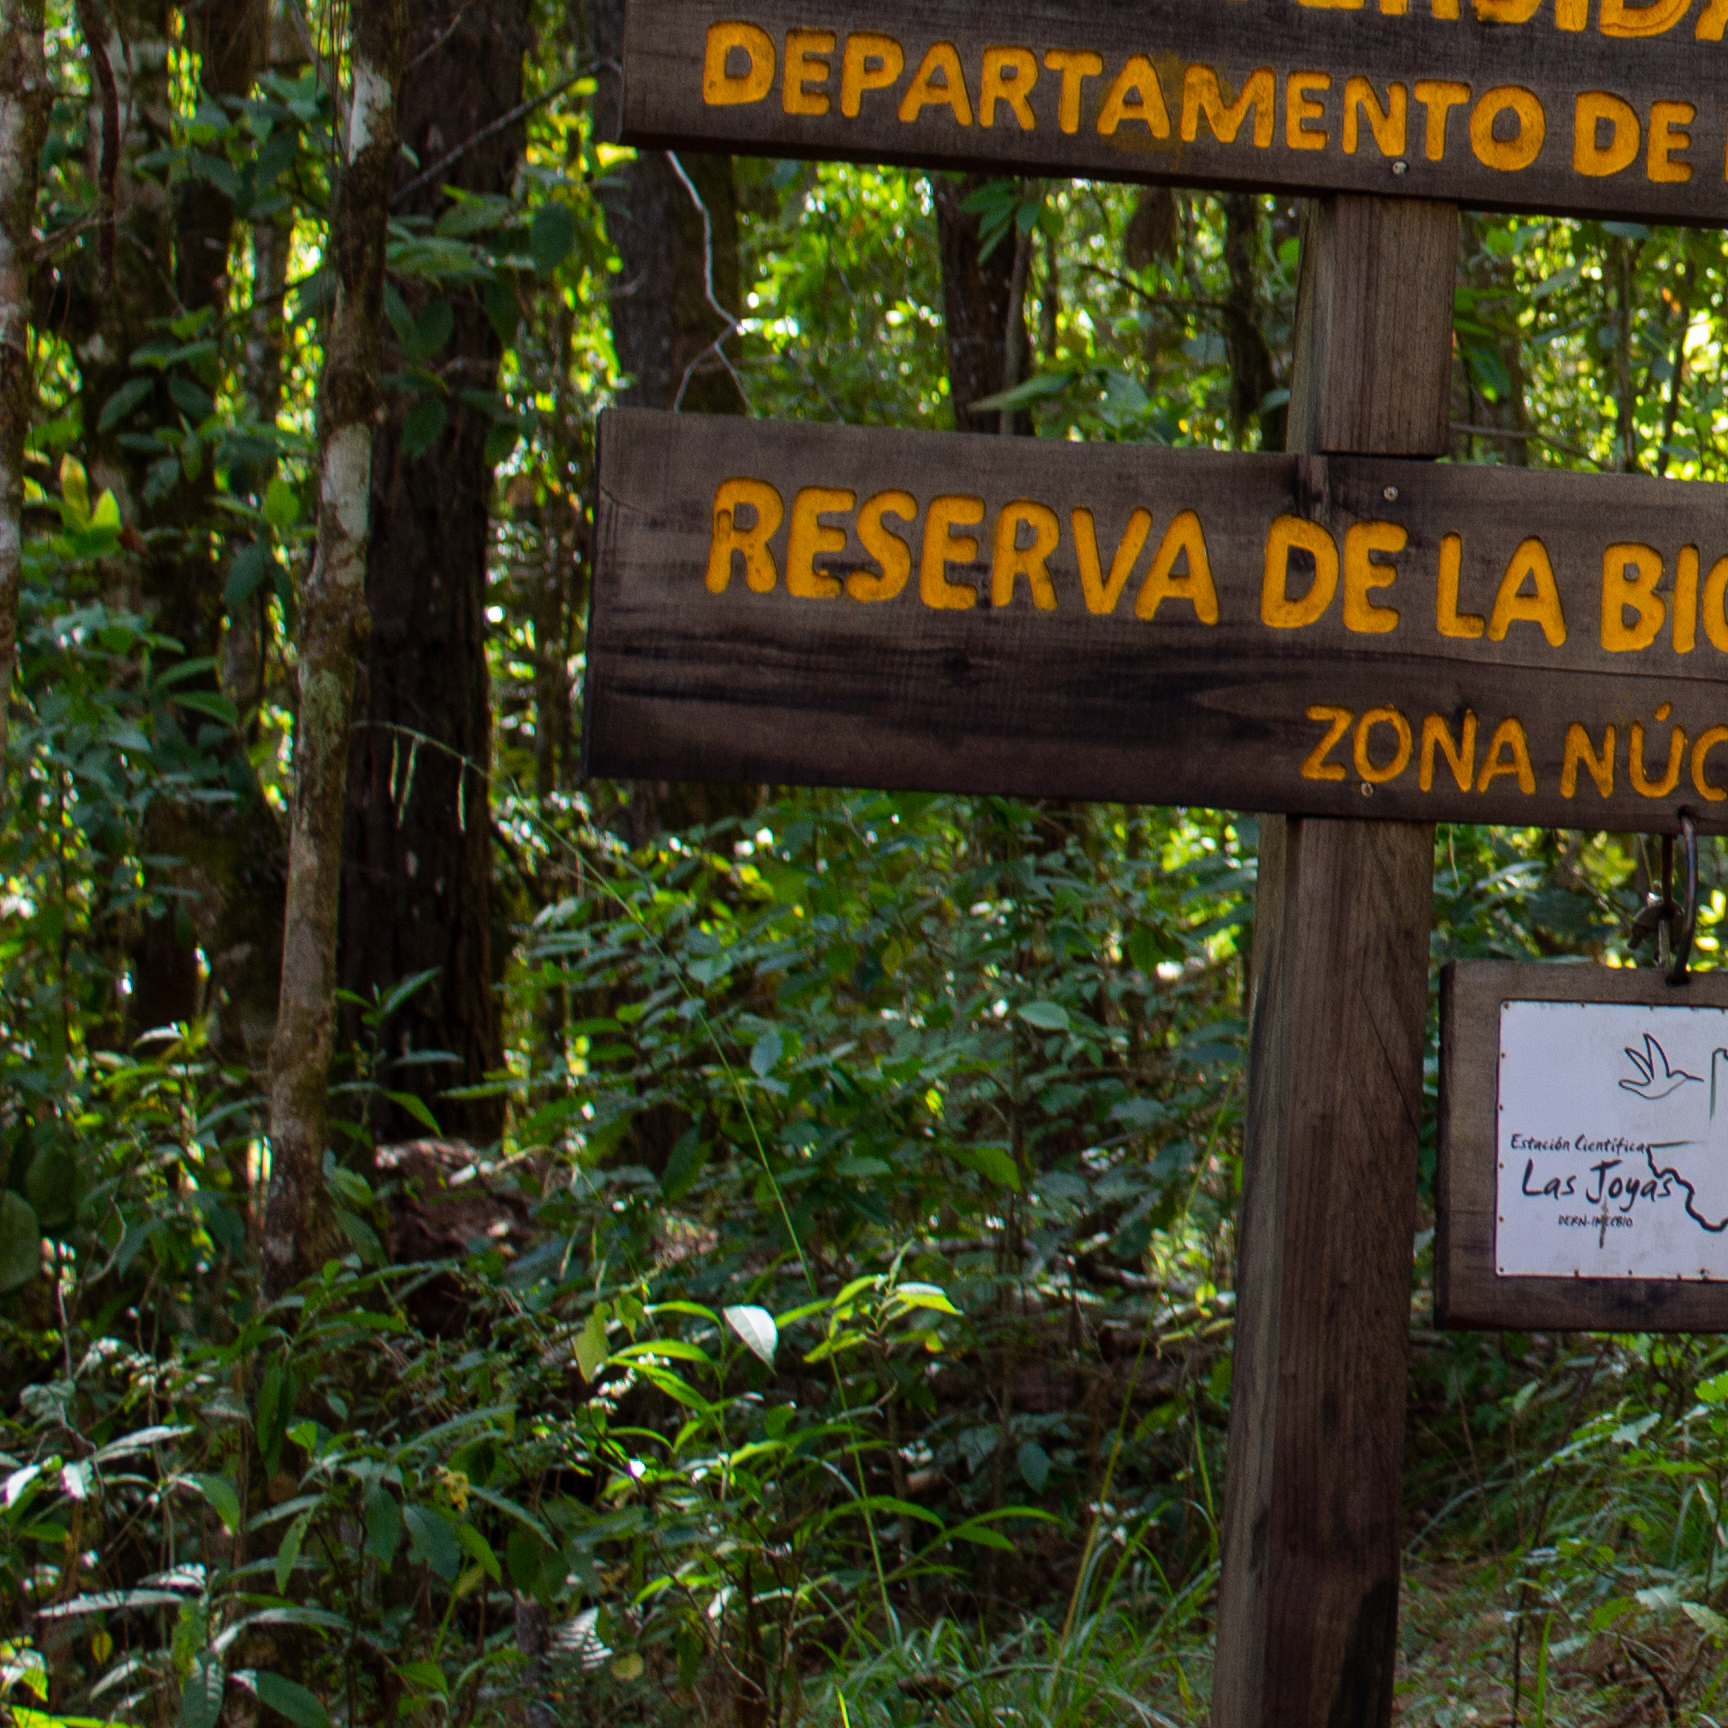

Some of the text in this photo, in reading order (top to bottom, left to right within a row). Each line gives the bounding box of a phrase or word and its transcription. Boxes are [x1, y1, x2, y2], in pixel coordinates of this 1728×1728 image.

[701, 22, 1546, 172] DEPARTAMENTO
[1572, 92, 1695, 183] DE
[704, 479, 1219, 625] RESERVA
[1260, 515, 1408, 634] DE
[1435, 536, 1568, 648] LA
[1301, 703, 1536, 795] ZONA
[1511, 1133, 1648, 1156] Estación Científica
[1522, 1157, 1673, 1213] Las Joyas
